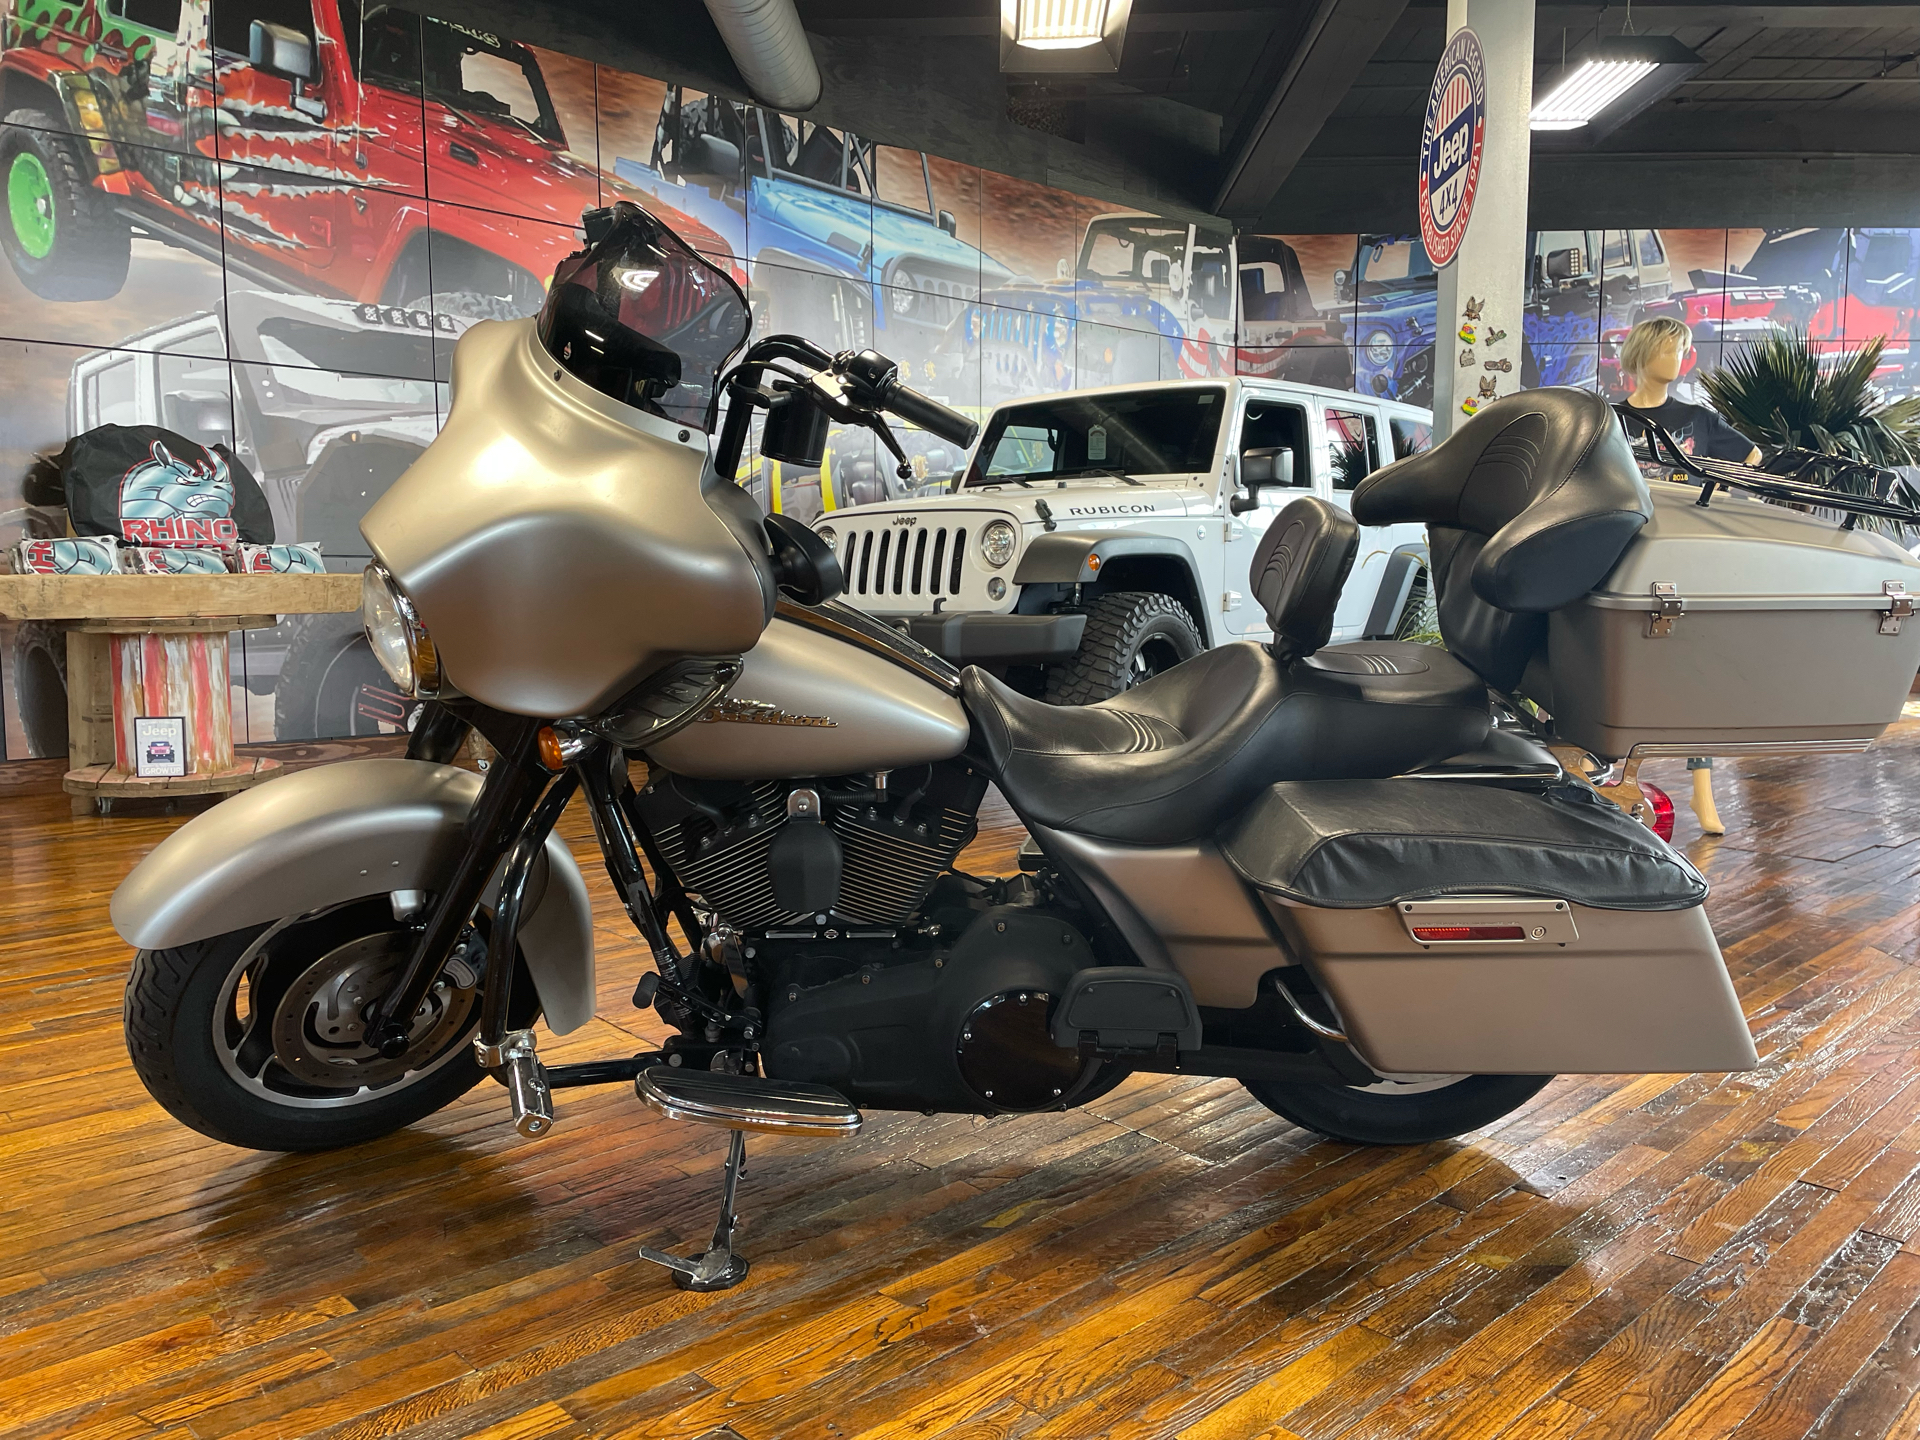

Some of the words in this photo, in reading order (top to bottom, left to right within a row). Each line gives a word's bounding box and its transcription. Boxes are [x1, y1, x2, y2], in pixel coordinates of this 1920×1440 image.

[1422, 116, 1433, 159] THE
[1430, 38, 1467, 115] AMERICAN
[1465, 39, 1484, 106] LEGEND
[1433, 122, 1469, 179] Jeep
[1421, 187, 1450, 258] ESTABLISHED
[1450, 196, 1470, 250] SINCE
[1467, 141, 1481, 194] 1941
[892, 514, 917, 527] Jeep
[1069, 504, 1156, 516] RUBICON
[120, 514, 239, 544] RHINO
[142, 725, 177, 738] Jeep
[145, 767, 169, 775] GROW
[171, 766, 182, 774] UP
